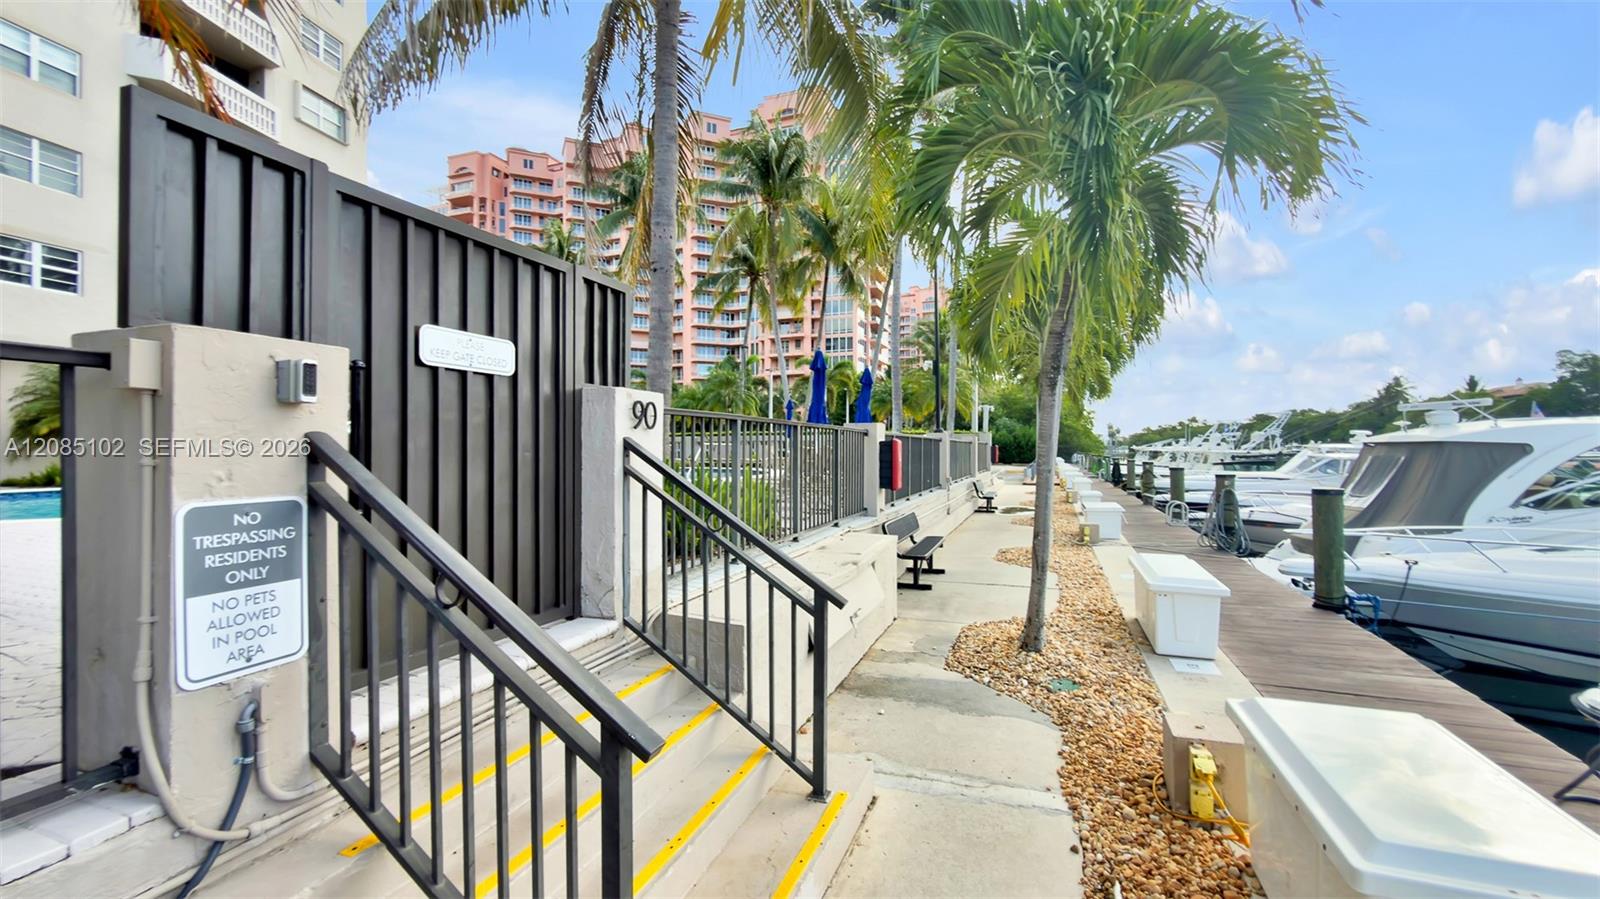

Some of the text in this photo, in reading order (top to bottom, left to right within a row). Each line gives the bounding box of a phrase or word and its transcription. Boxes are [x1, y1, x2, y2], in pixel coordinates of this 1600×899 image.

[430, 347, 508, 369] KEEP GATE CLOSED
[632, 400, 657, 430] 90
[233, 511, 262, 526] NO
[193, 526, 297, 550] TRESPASSING
[204, 545, 288, 569] RESIDENTS
[225, 565, 270, 585] ONLY
[211, 590, 278, 614] NO PETS
[206, 606, 281, 633] ALLOWED
[212, 624, 278, 649] IN POOL
[226, 644, 265, 664] AREA
